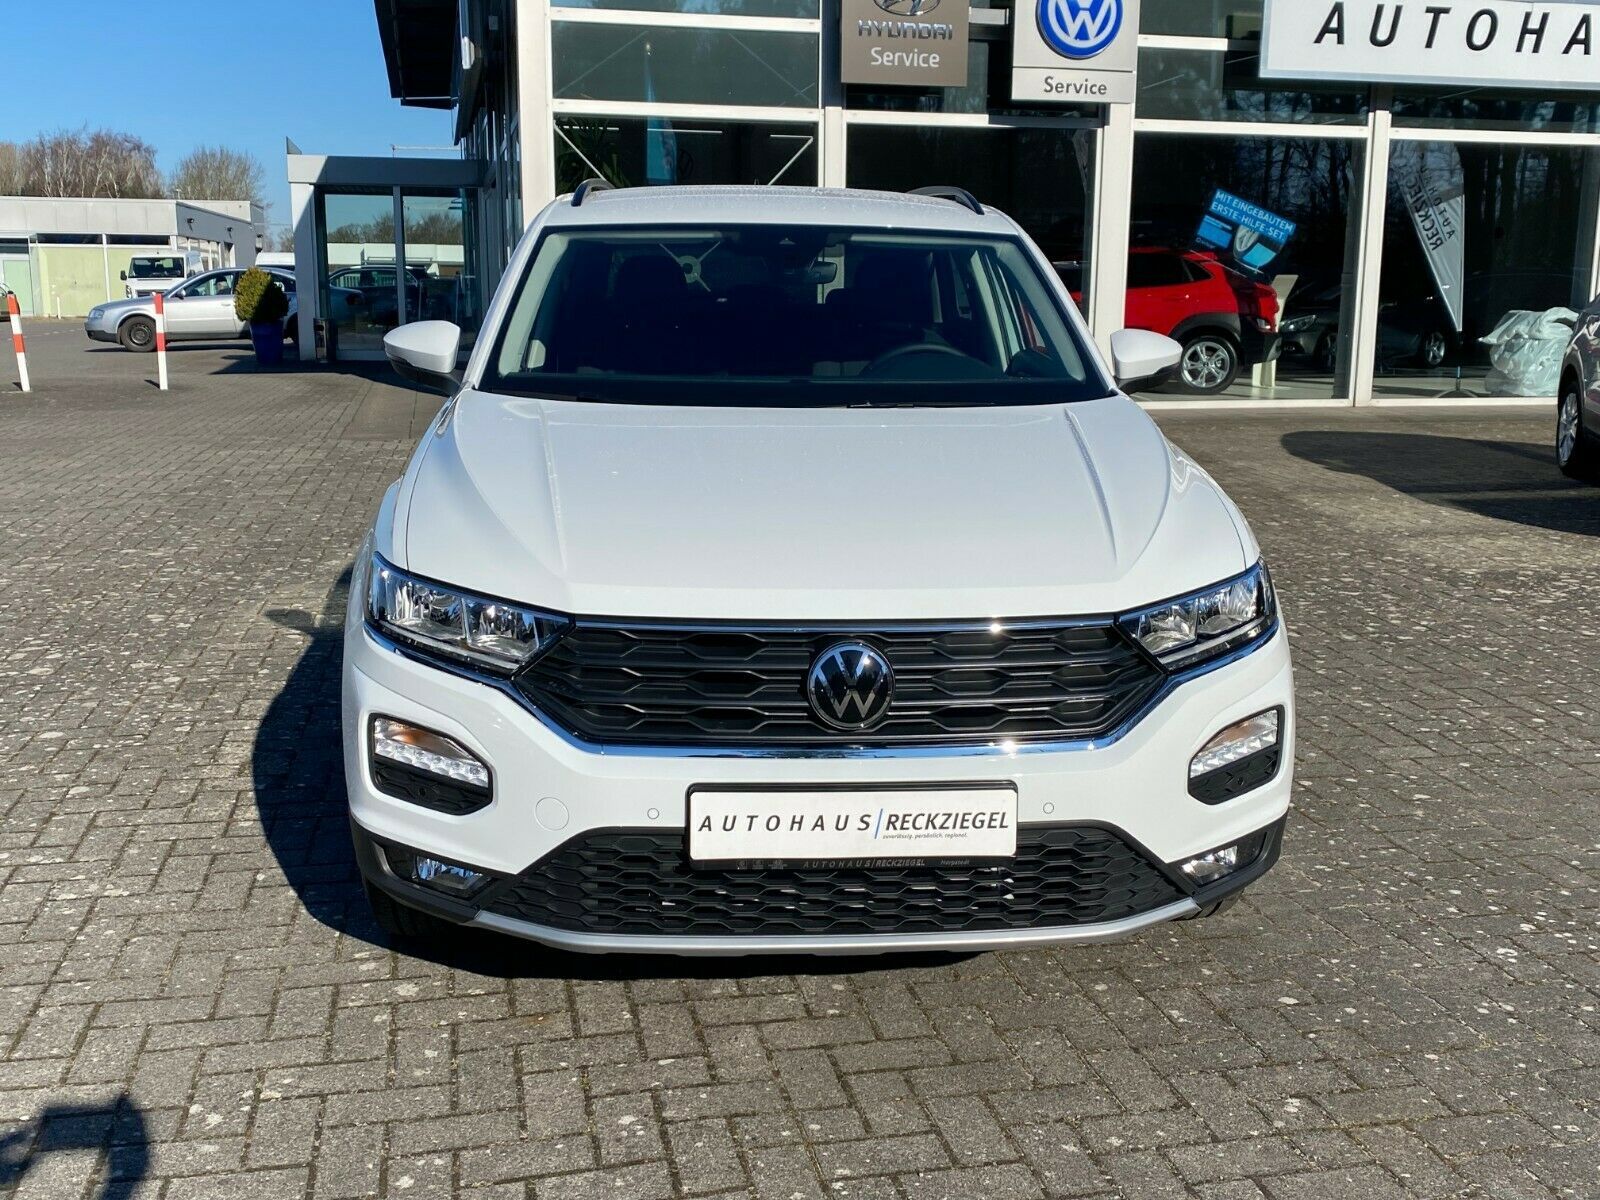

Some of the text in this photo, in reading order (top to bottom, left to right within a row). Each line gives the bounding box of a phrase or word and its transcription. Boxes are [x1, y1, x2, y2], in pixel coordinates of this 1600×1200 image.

[858, 20, 953, 40] HYUNDAI
[870, 47, 940, 68] Service
[1044, 76, 1107, 95] Service
[1215, 191, 1294, 232] MIT EINGEBAUTEM
[699, 811, 1009, 832] AUTOHAUS RECKZIEGEL
[803, 859, 925, 868] AUTOHAUS RECKZIEGEL
